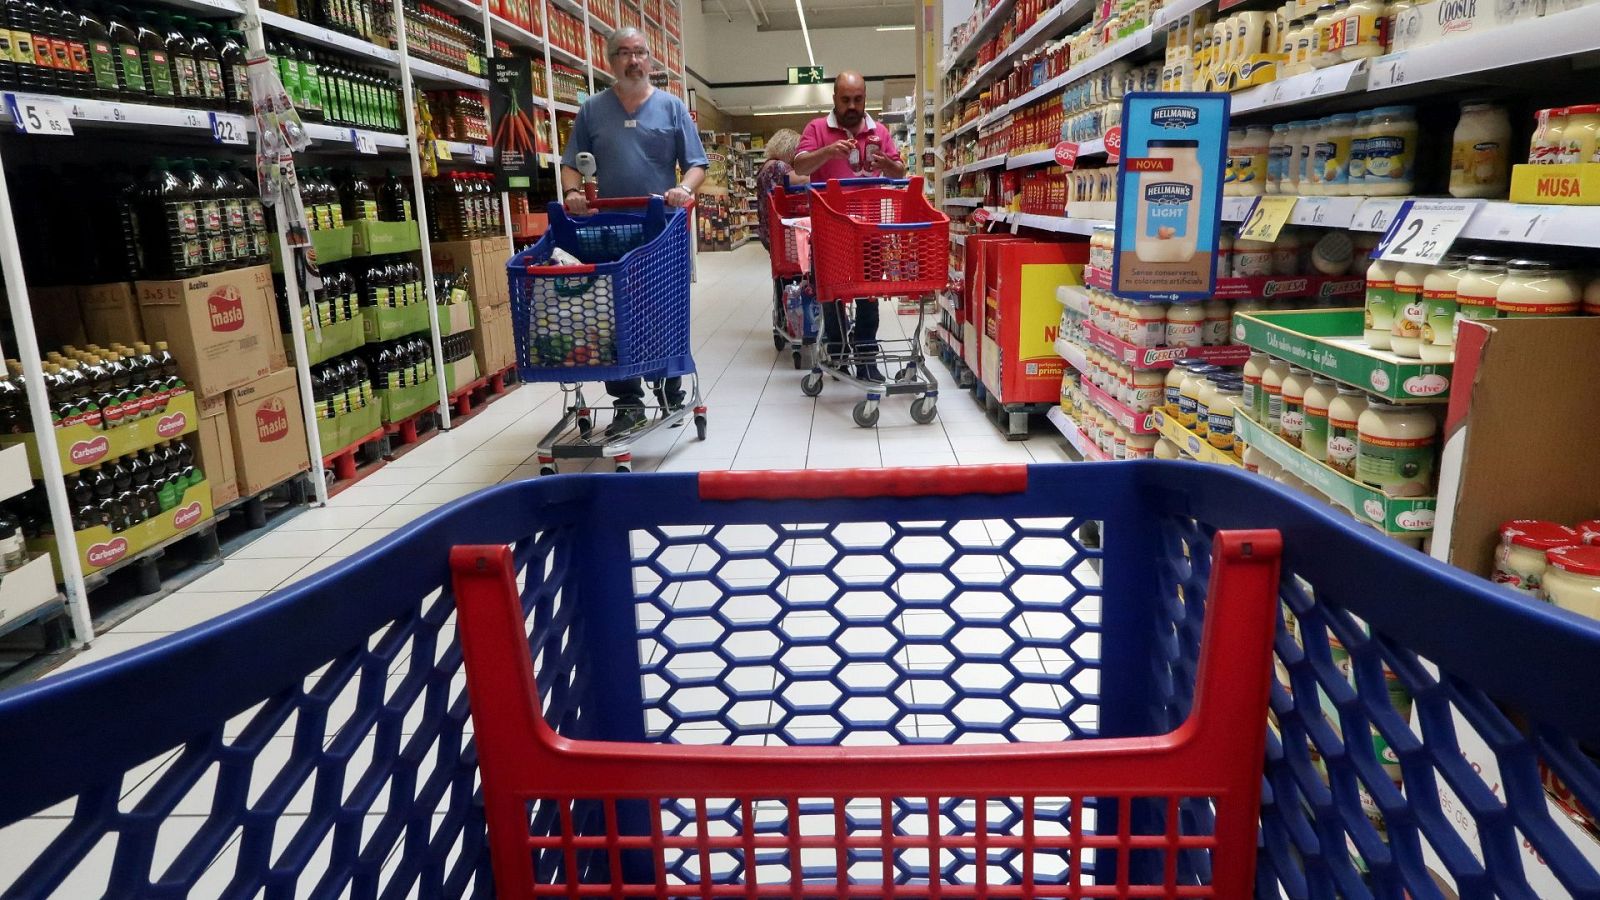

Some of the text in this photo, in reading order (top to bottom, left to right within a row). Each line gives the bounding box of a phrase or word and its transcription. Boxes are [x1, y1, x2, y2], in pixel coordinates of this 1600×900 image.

[1390, 62, 1397, 84] 1
[26, 105, 42, 130] 5
[1153, 108, 1197, 120] HELLMANN'S
[217, 120, 235, 141] 22
[1055, 149, 1073, 161] -50%
[1136, 160, 1164, 170] NOVA
[1147, 184, 1191, 196] HELLMANN'S
[1537, 178, 1581, 197] MUSA
[1151, 208, 1184, 218] LIGHT
[1245, 208, 1265, 236] 2
[1524, 214, 1541, 238] 1
[1391, 219, 1424, 255] 2
[1416, 241, 1437, 257] 32
[188, 280, 209, 291] Aceites
[209, 303, 217, 314] la
[1407, 307, 1423, 316] Ca
[1144, 349, 1186, 365] LIGERESA
[236, 386, 256, 397] Aceites
[158, 417, 185, 433] Carbonell
[257, 417, 265, 425] la
[72, 442, 107, 459] Carbonell
[175, 505, 201, 525] Carbonell
[90, 542, 126, 561] Carbonell
